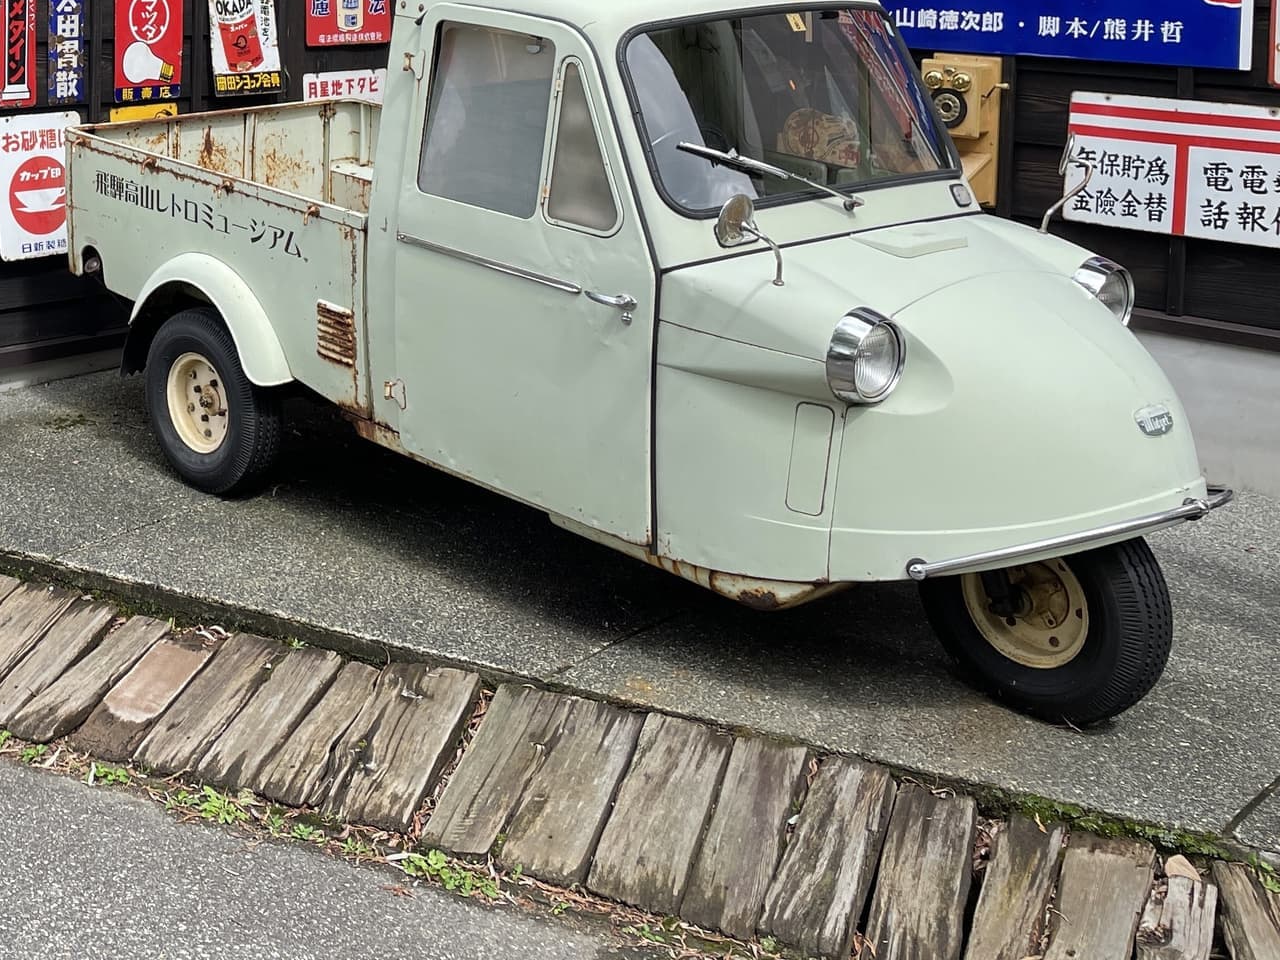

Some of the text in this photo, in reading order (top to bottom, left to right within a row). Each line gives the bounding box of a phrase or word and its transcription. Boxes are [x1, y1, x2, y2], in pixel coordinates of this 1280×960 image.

[896, 8, 1005, 33] 山崎徳次郎
[308, 76, 380, 99] 月星地下タビ
[20, 167, 62, 182] カップ印
